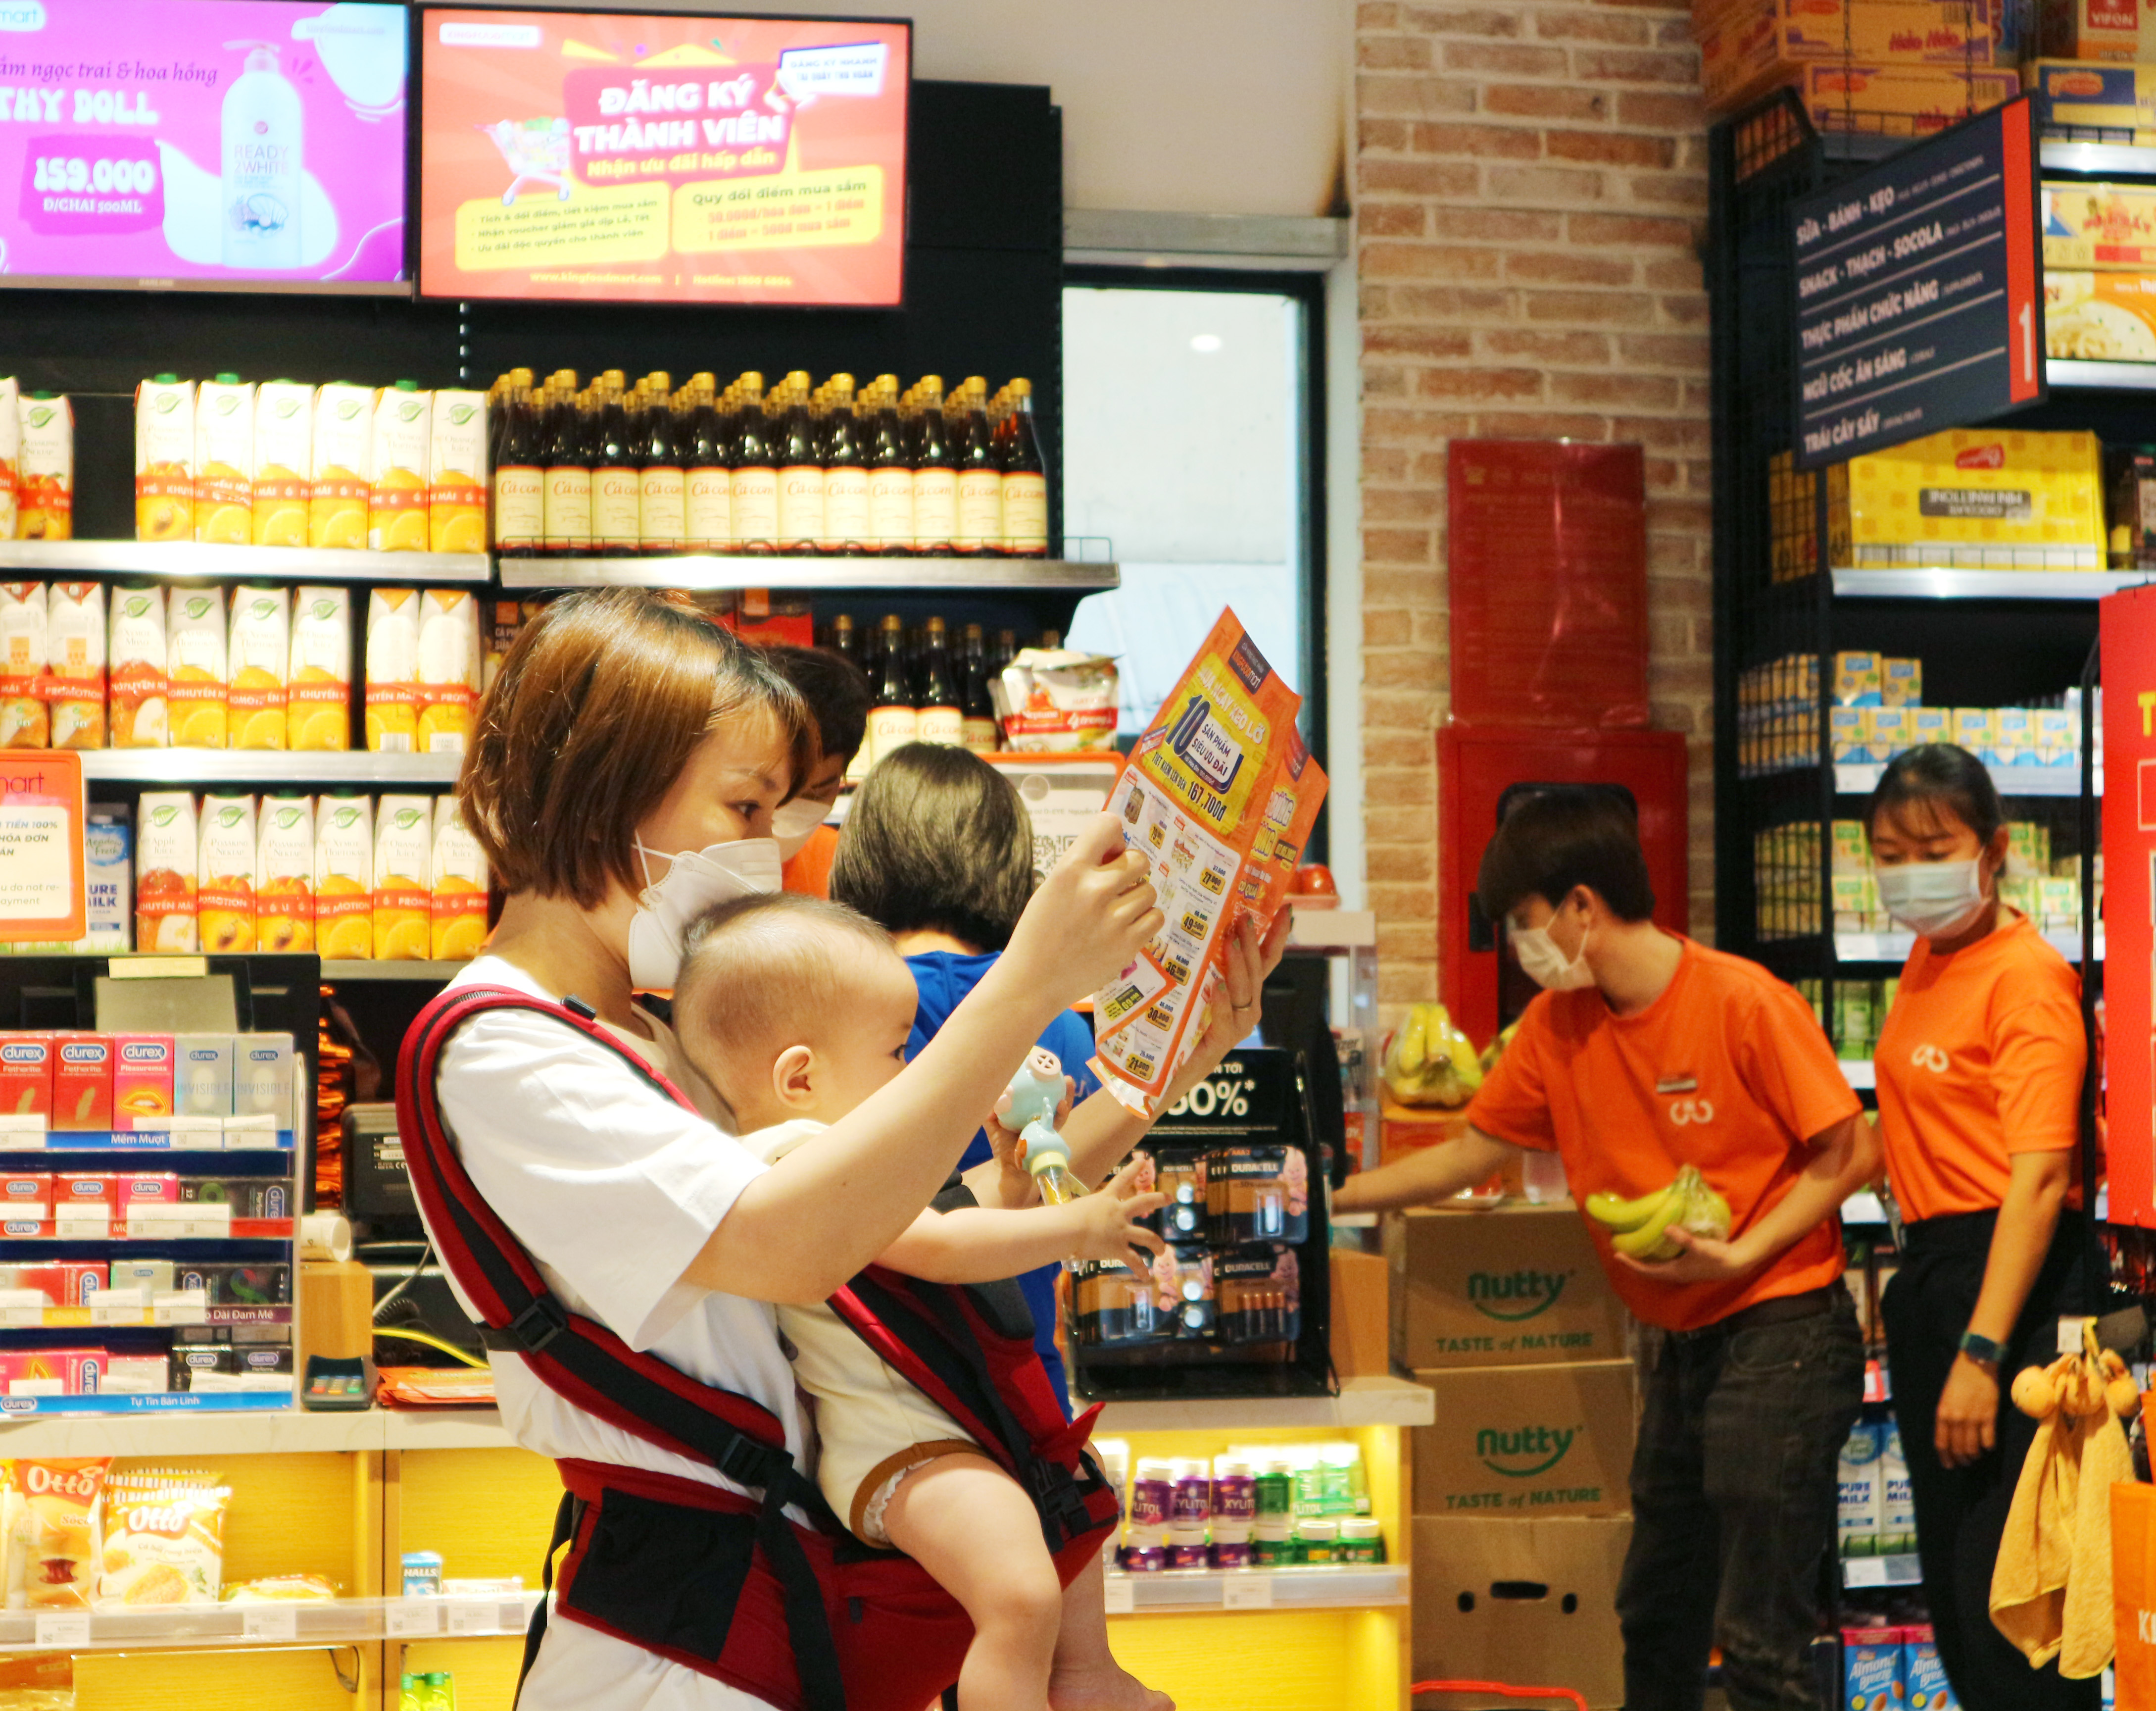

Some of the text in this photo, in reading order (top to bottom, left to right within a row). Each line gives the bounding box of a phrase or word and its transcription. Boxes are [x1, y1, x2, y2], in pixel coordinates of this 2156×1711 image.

[2091, 10, 2135, 26] VIFON
[31, 62, 74, 82] ngọc
[78, 61, 111, 79] trai
[134, 61, 168, 80] hoa
[172, 62, 218, 86] hồng
[598, 73, 754, 114] ĐĂNG KÝ
[73, 89, 158, 125] DOLL
[573, 109, 783, 152] THÀNH VIÊN
[234, 145, 289, 161] READY
[233, 161, 289, 176] 2WHITE
[587, 158, 636, 178] Nhận
[701, 150, 736, 171] hấp
[739, 146, 776, 166] dẫn
[34, 157, 153, 194] 159.000
[693, 194, 722, 205] Quy
[798, 185, 831, 196] mua
[507, 224, 549, 234] voucher
[569, 234, 587, 244] cho
[1799, 265, 1838, 298] SNACK
[1894, 221, 1944, 259] SOCOLA
[2019, 302, 2033, 383] 1
[1165, 694, 1210, 756] 10
[1201, 722, 1231, 758] SẢN PHẨM
[1191, 738, 1206, 759] SIÊU
[1211, 757, 1228, 776] ĐÃI
[1187, 781, 1227, 822] 167.700đ
[32, 820, 58, 829] 100%
[25, 833, 49, 843] ĐƠN
[25, 883, 43, 892] not
[4, 1045, 43, 1060] durex
[65, 1045, 103, 1060] durex
[126, 1045, 164, 1059] durex
[192, 1052, 217, 1060] durex
[251, 1052, 277, 1060] durex
[3, 1065, 41, 1073] Fetherlite
[63, 1065, 102, 1073] Fetherlite
[120, 1064, 167, 1072] Pleasuremax
[1225, 1061, 1243, 1074] TỚI
[111, 1132, 164, 1146] Mềm Mượt
[9, 1183, 36, 1193] durex
[74, 1183, 101, 1193] durex
[134, 1182, 160, 1193] durex
[8, 1222, 38, 1233] durex
[1468, 1270, 1566, 1321] nutty
[213, 1309, 274, 1319] Dài Đam Mê
[1437, 1337, 1493, 1352] TASTE
[1521, 1332, 1593, 1349] NATURE
[189, 1355, 215, 1366] durex
[250, 1354, 278, 1364] durex
[4, 1399, 35, 1410] durex
[131, 1398, 143, 1408] Tự
[145, 1396, 159, 1406] Tin
[1477, 1426, 1574, 1477] nutty
[27, 1466, 94, 1496] Otto
[1446, 1493, 1502, 1510] TASTE
[1530, 1487, 1601, 1504] NATURE
[128, 1506, 185, 1531] Otto
[403, 1568, 438, 1577] HALLS
